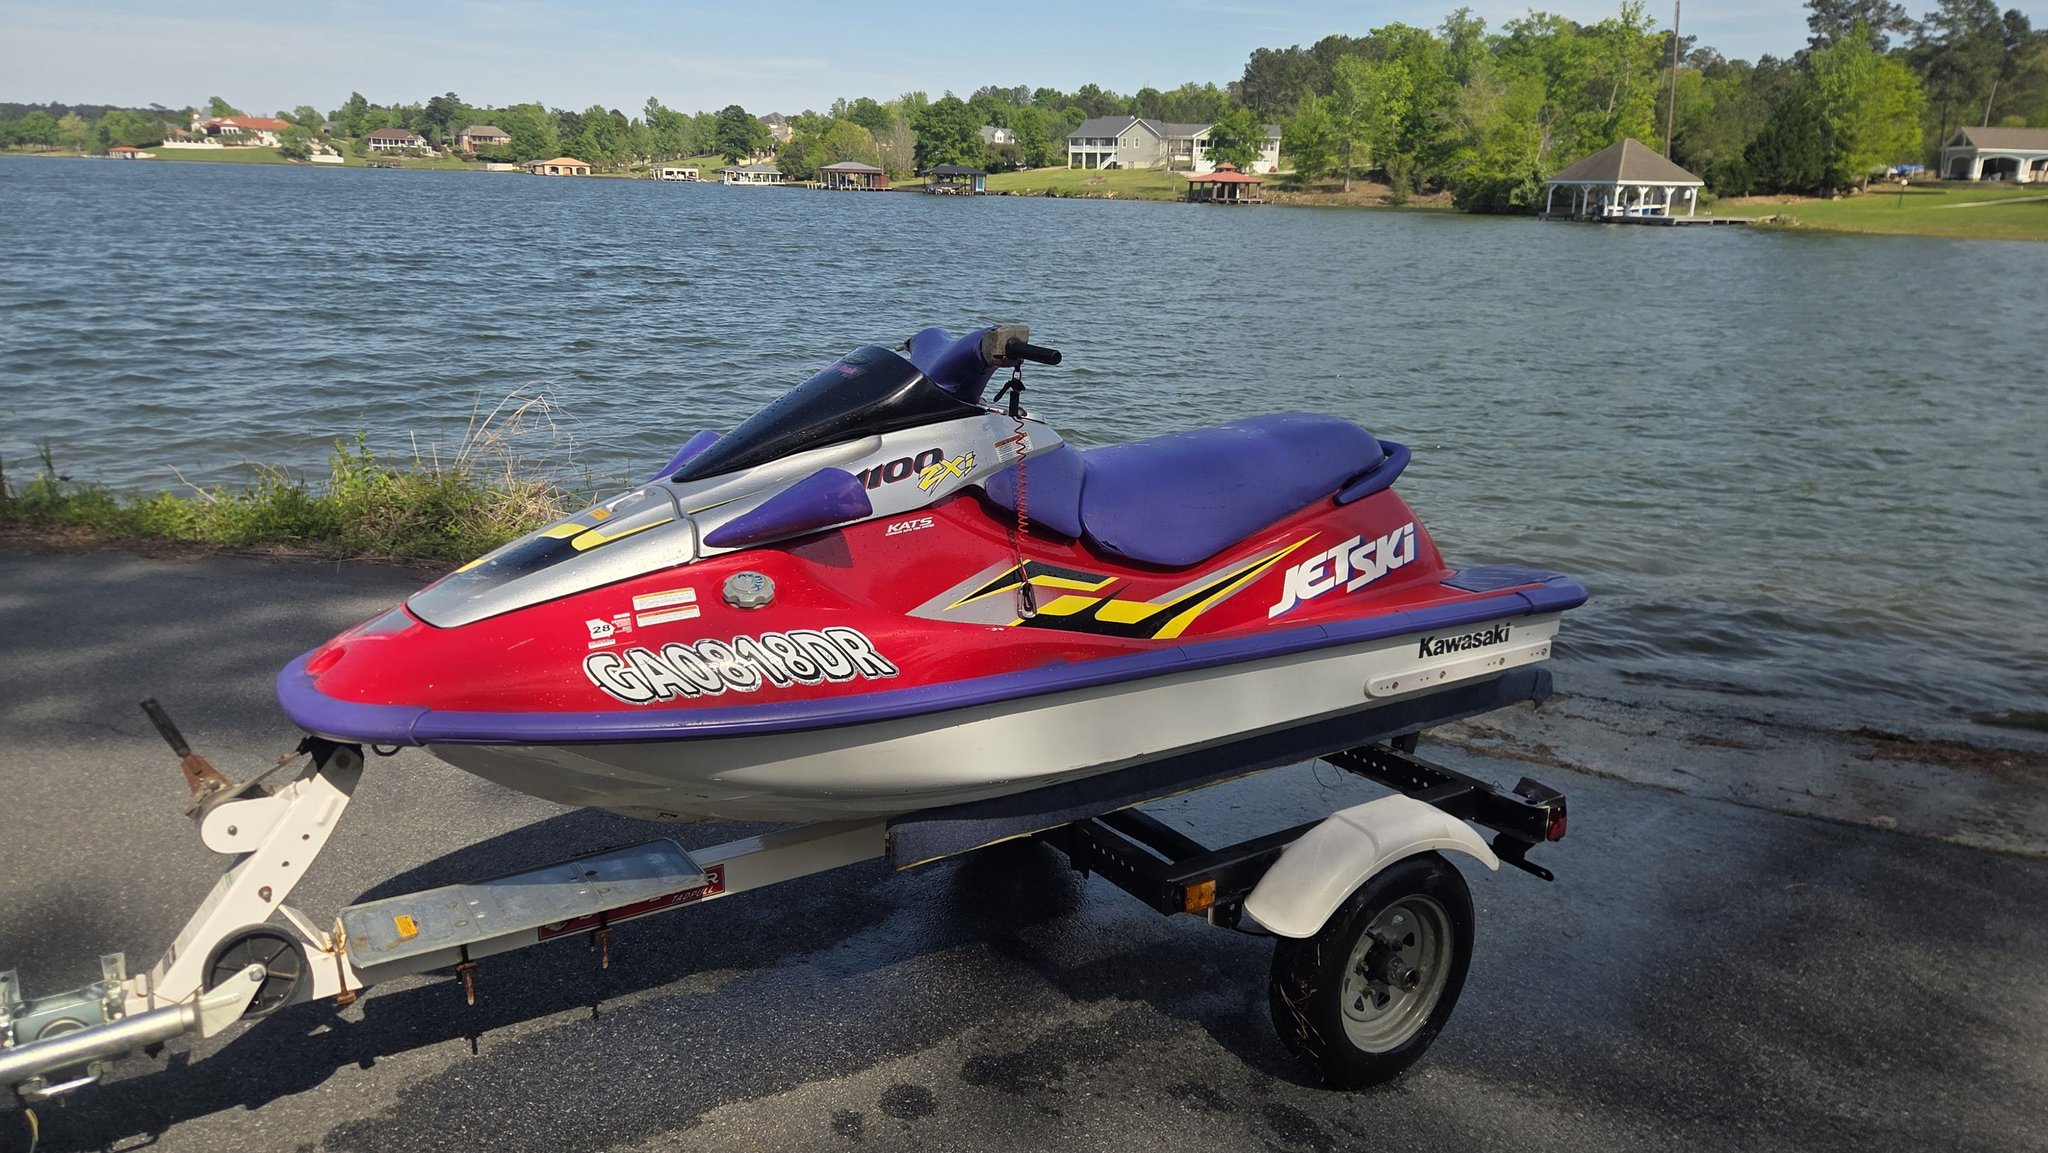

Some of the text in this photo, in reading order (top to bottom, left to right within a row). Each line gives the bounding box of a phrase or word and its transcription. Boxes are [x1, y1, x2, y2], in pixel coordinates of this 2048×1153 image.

[887, 516, 933, 533] KATS
[592, 624, 611, 635] 28
[1418, 622, 1512, 659] Kawasaki
[583, 626, 899, 705] GA0818DR
[671, 885, 714, 903] TADPULL
